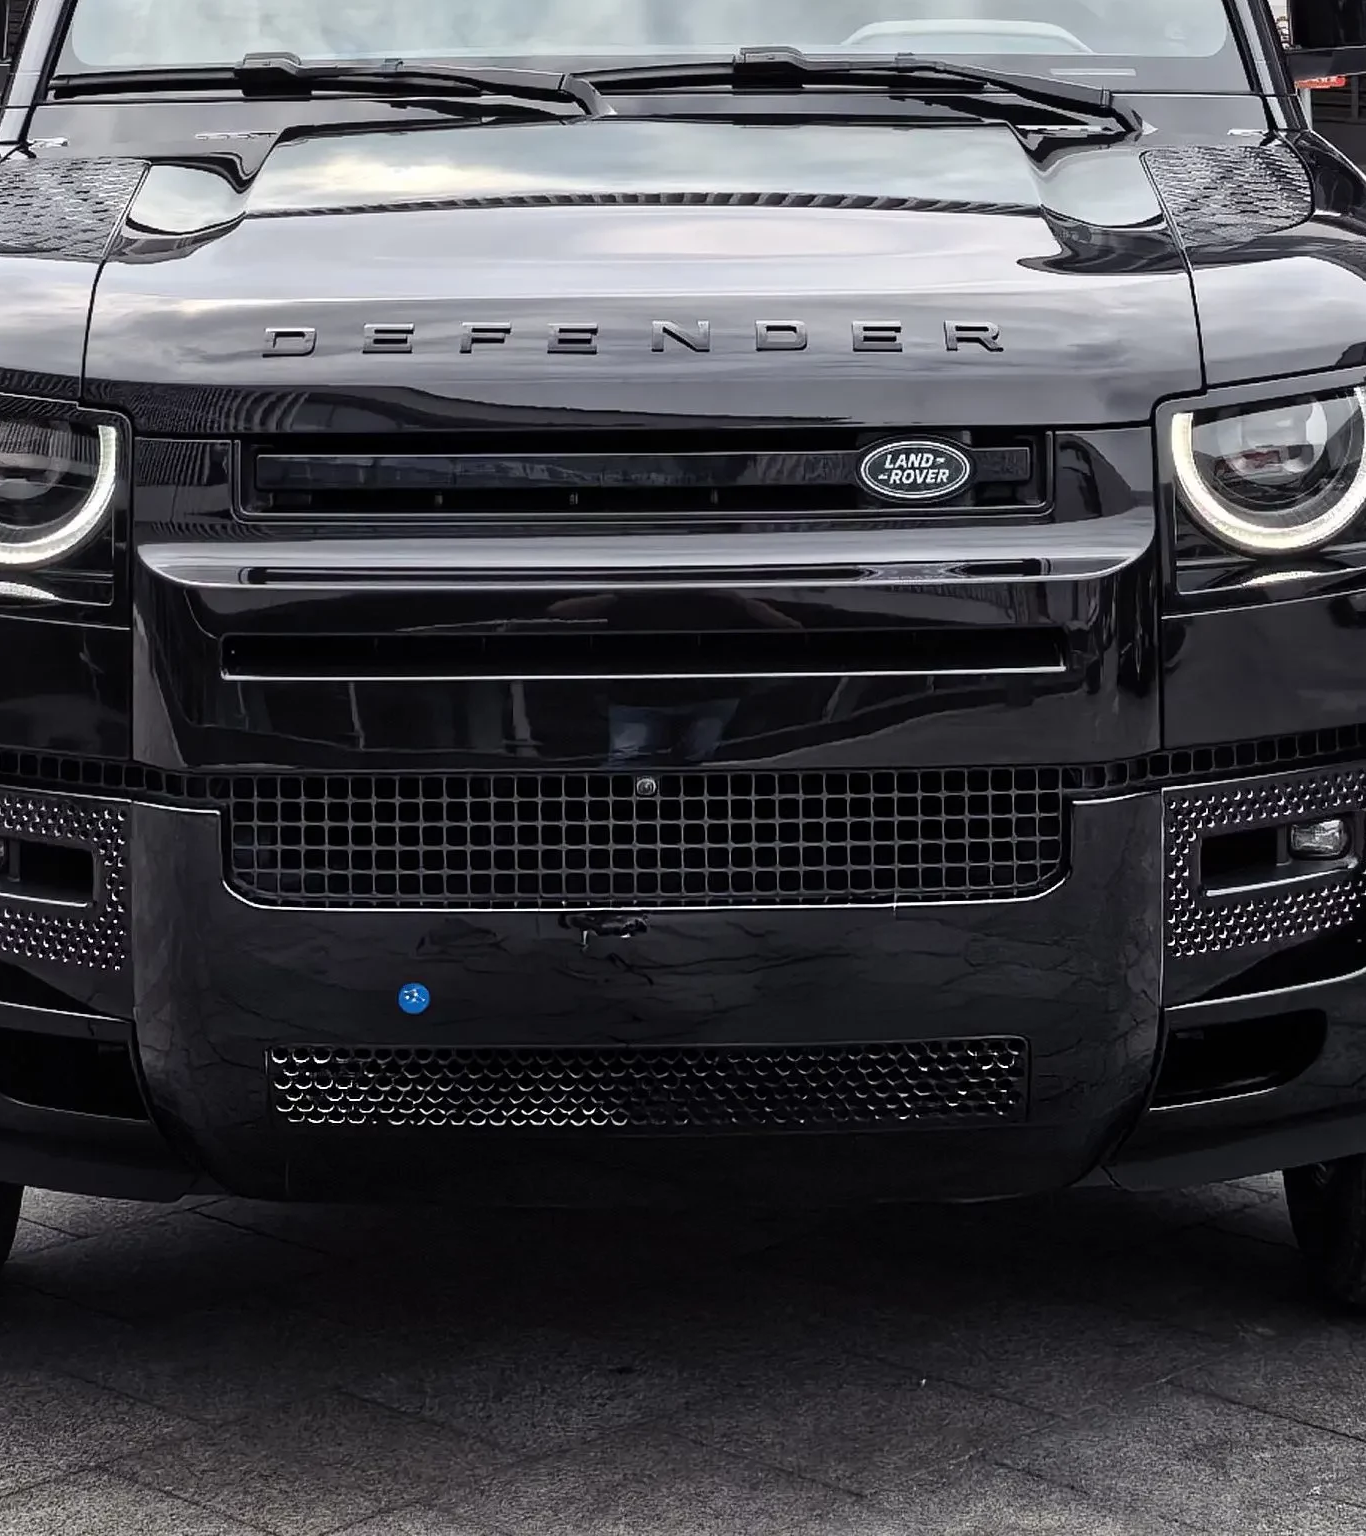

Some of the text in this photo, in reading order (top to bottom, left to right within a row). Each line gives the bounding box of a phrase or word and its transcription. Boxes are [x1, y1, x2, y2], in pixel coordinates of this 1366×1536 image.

[262, 319, 1004, 358] DEFENDER
[884, 453, 934, 469] LAND
[889, 469, 950, 484] ROVER
